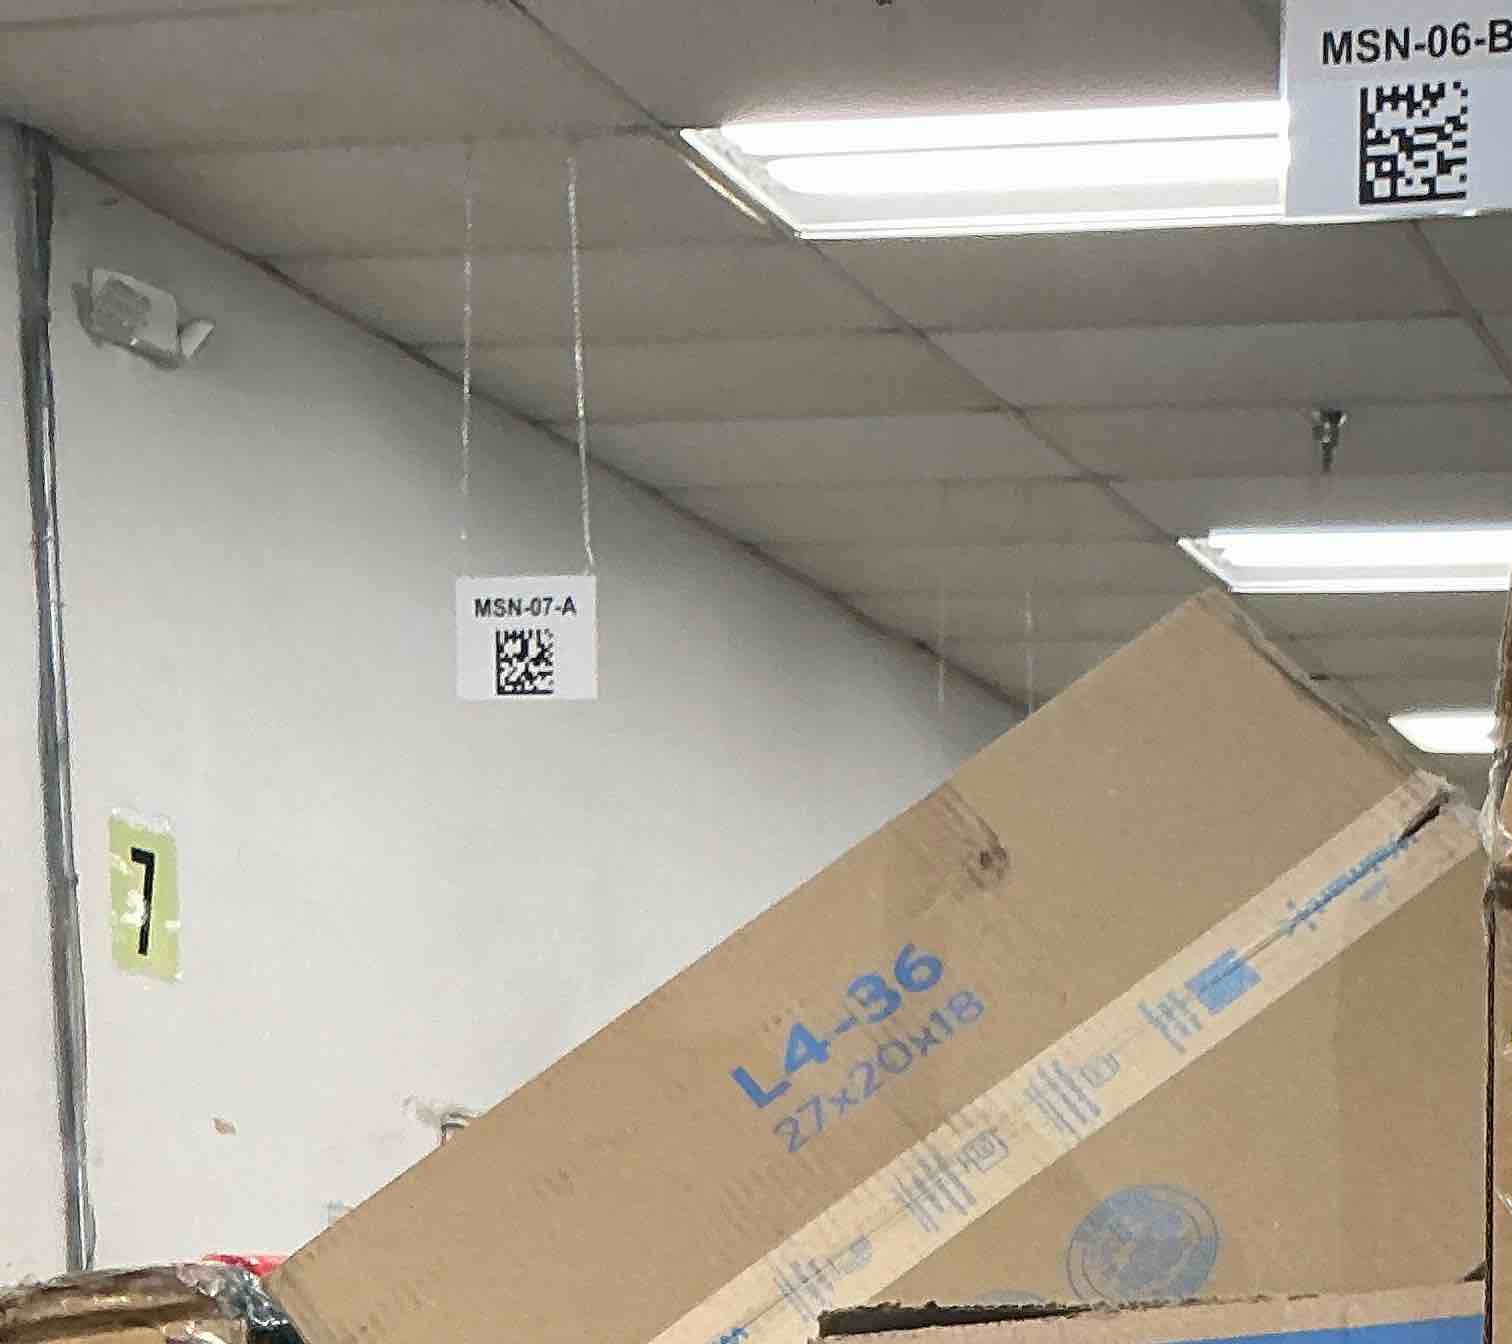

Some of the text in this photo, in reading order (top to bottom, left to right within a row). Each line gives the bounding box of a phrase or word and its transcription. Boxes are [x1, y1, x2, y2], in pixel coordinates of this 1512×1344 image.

[473, 597, 578, 618] MSN-07-A
[130, 846, 156, 956] 7
[730, 942, 946, 1110] L4-36
